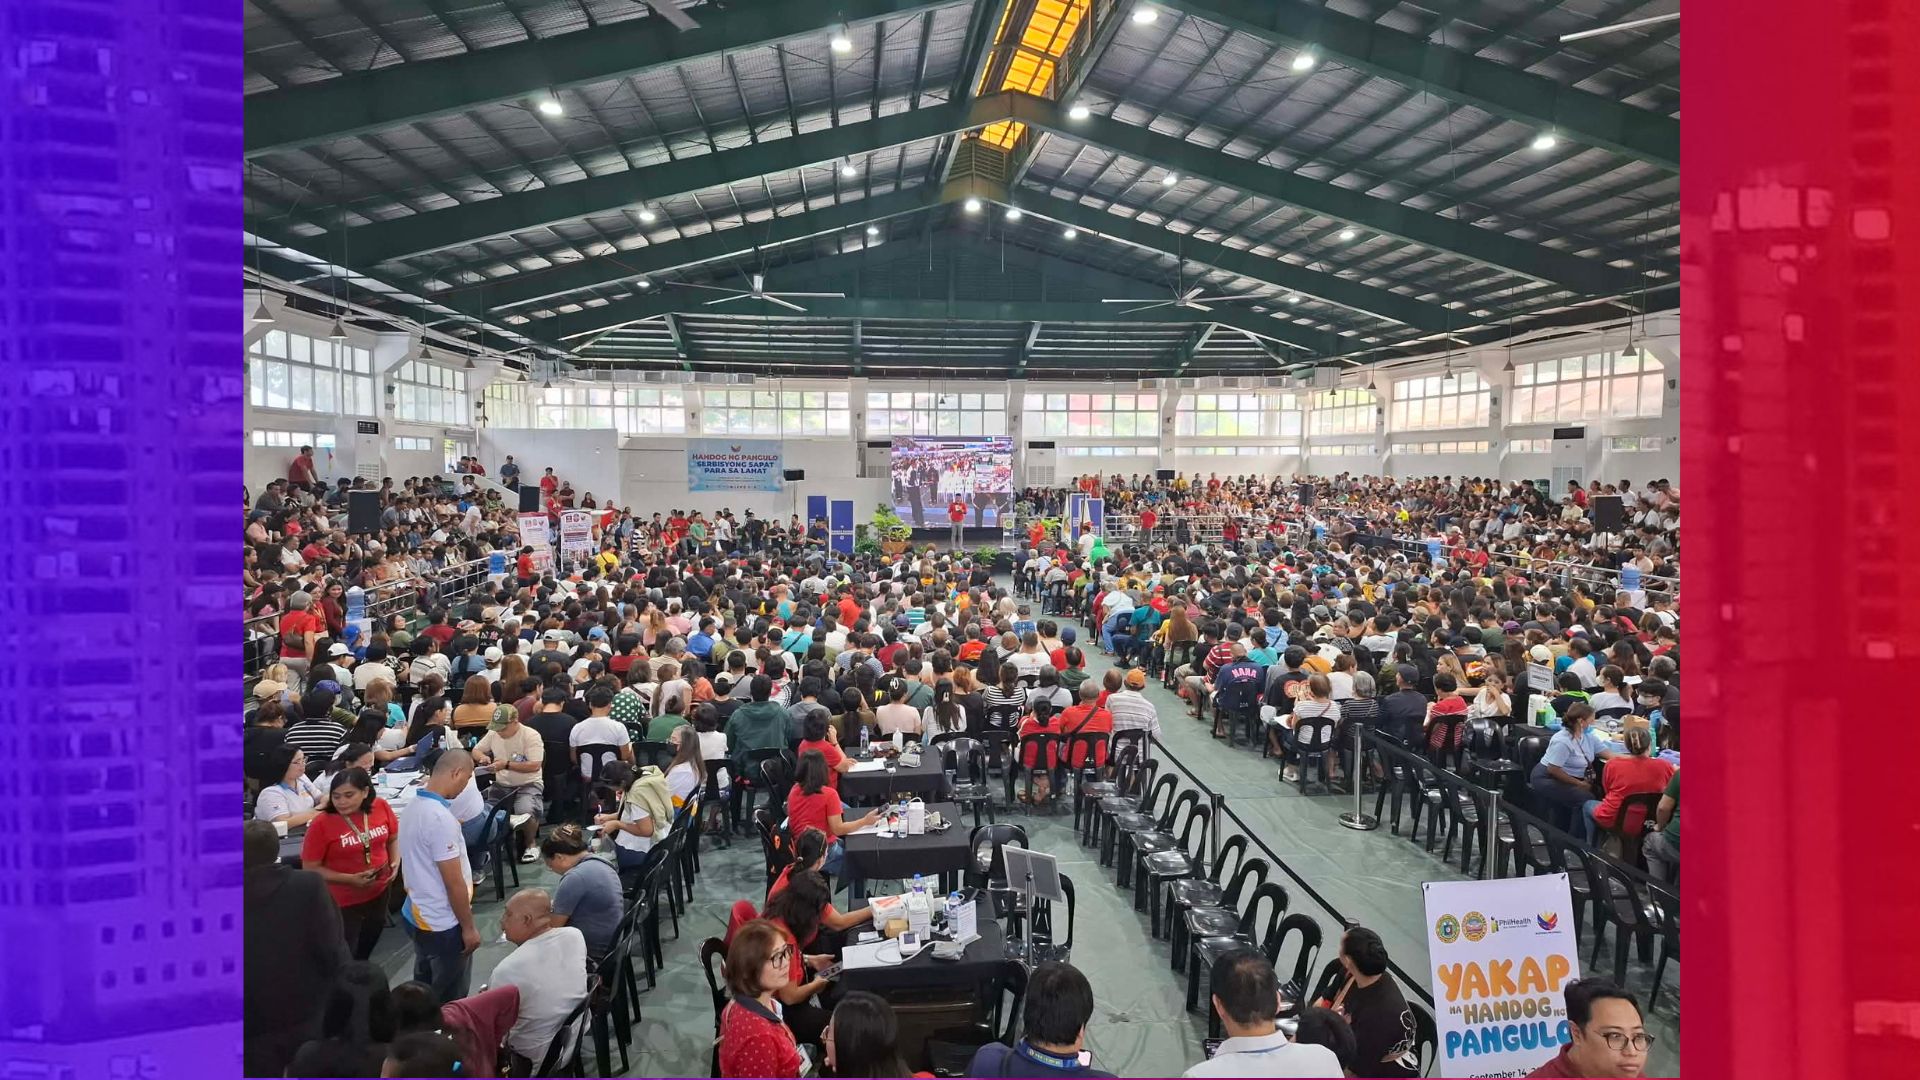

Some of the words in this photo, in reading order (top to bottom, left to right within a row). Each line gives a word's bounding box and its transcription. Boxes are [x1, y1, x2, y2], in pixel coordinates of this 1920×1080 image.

[1437, 954, 1570, 1002] YAKAP
[1449, 1005, 1462, 1015] NA
[1463, 997, 1552, 1025] HANDOG
[1445, 1020, 1572, 1059] PANGULO
